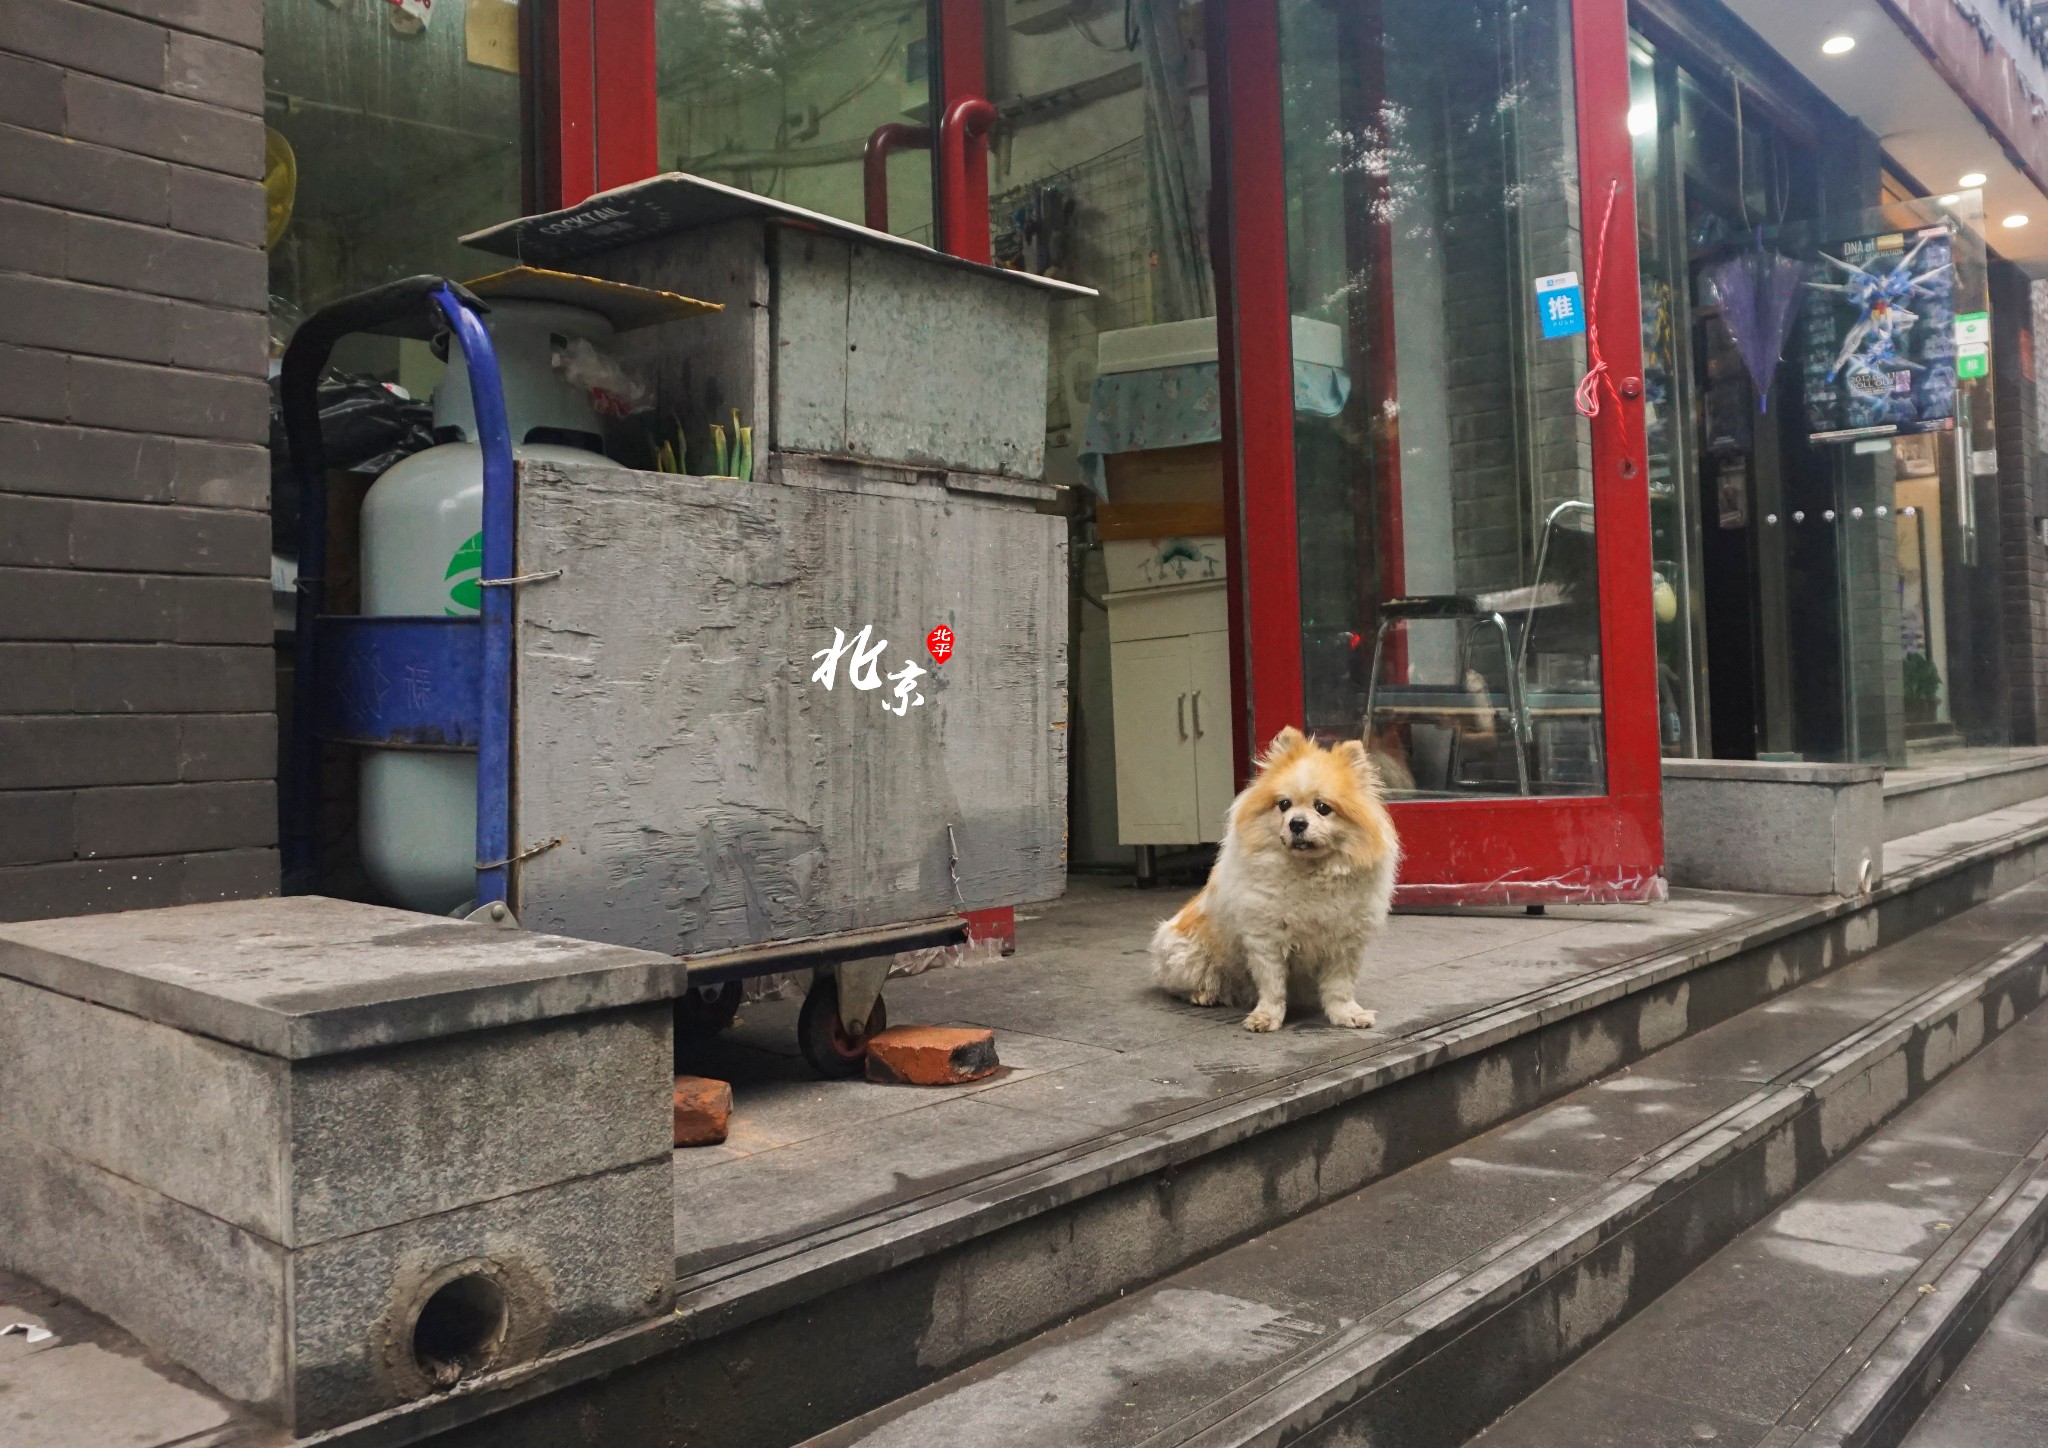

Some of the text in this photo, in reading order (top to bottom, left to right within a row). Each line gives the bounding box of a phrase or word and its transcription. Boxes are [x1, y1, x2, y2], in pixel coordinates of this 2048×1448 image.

[539, 206, 630, 235] COCKTAIL
[1844, 240, 1864, 256] DNA
[1548, 295, 1575, 320] 推
